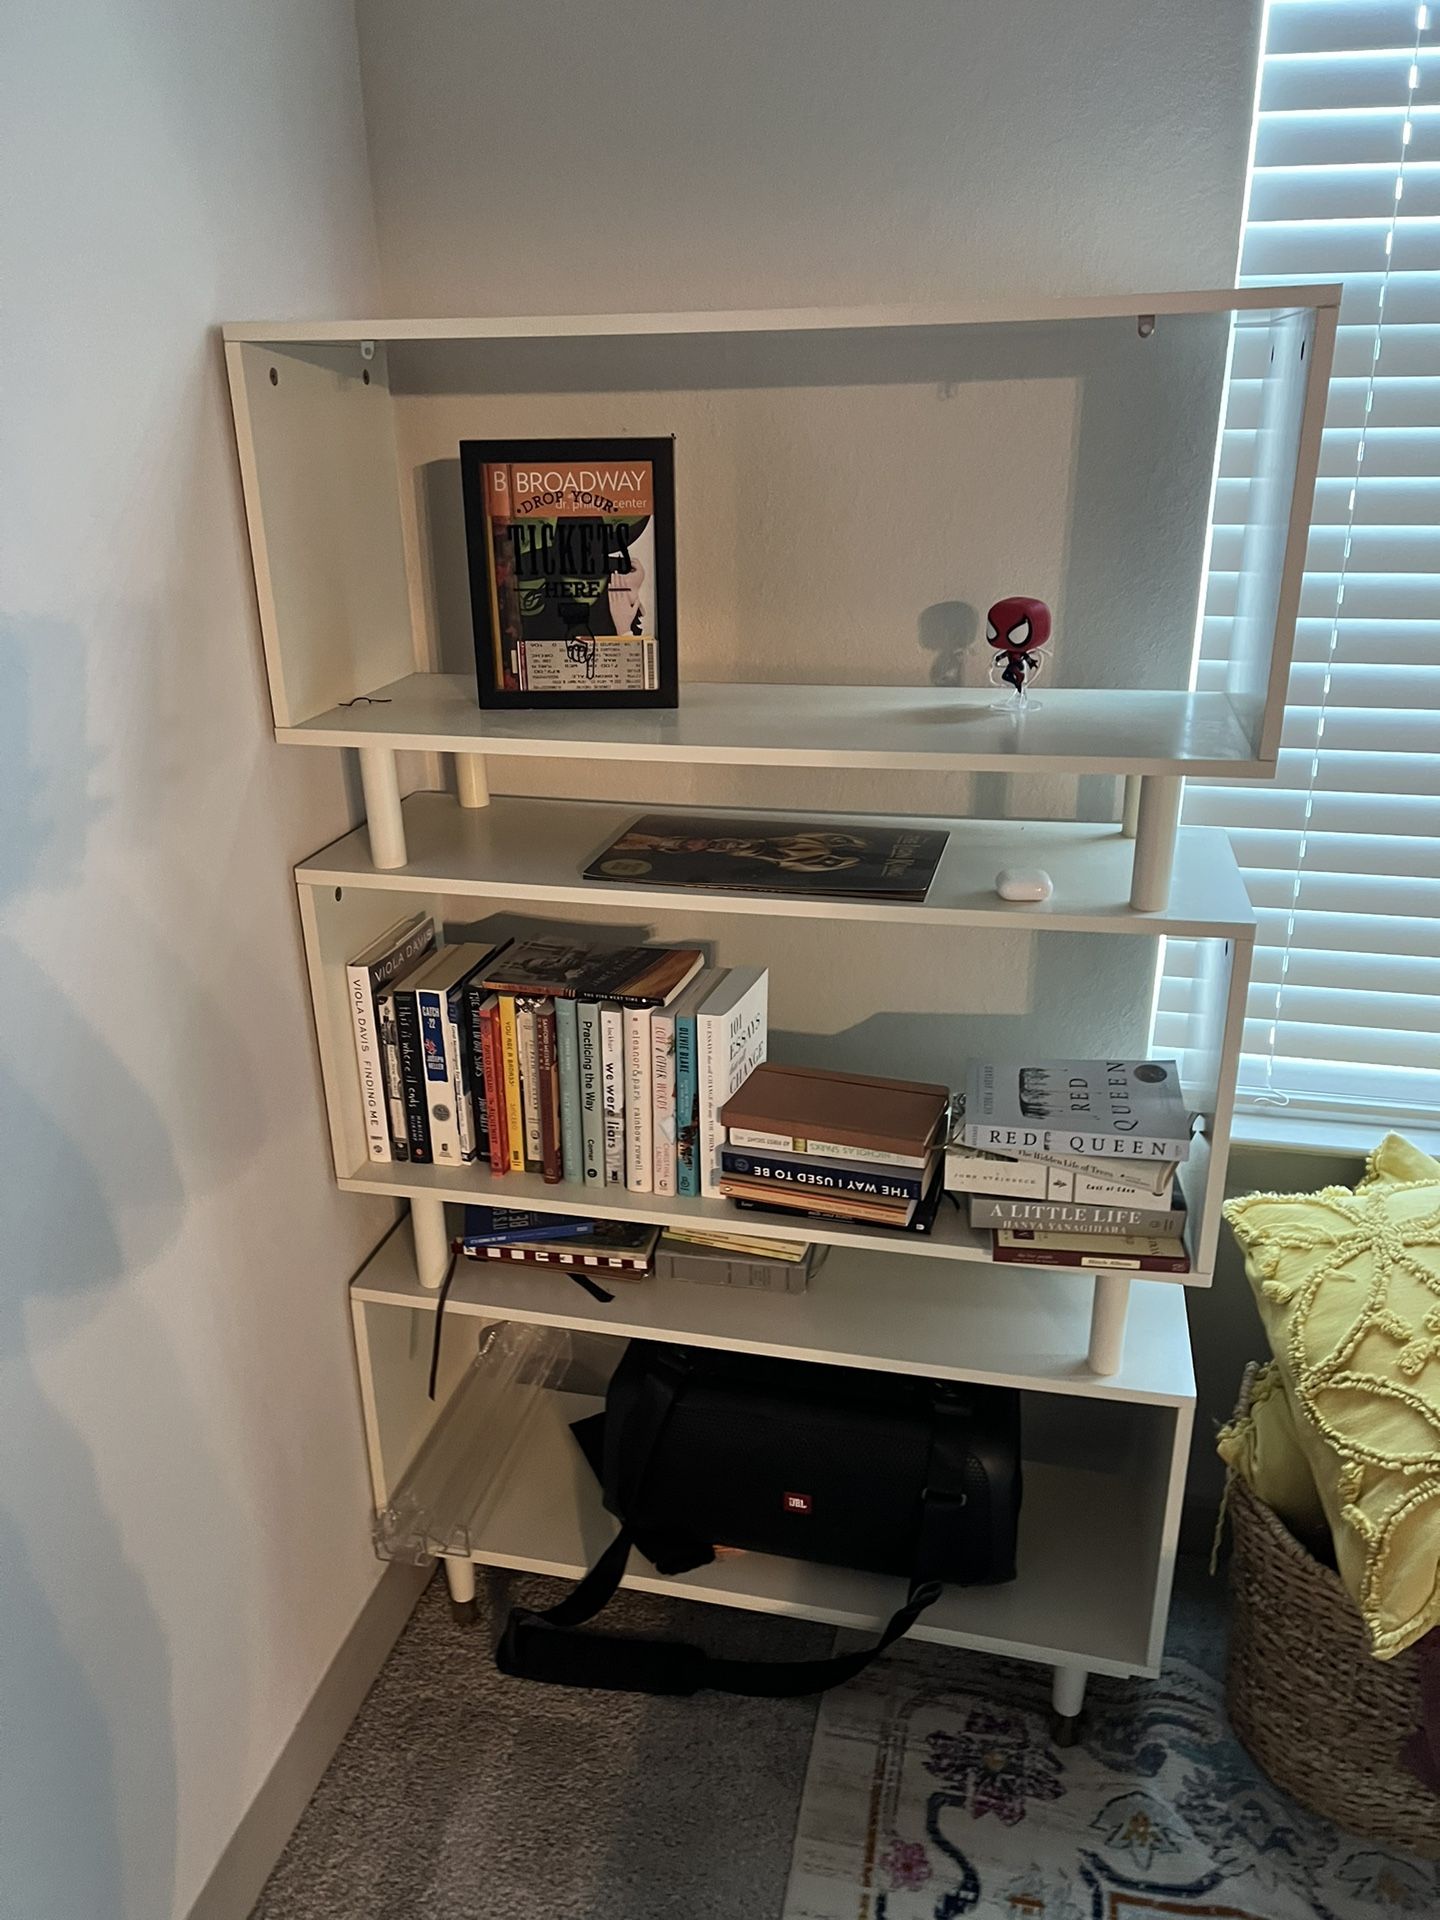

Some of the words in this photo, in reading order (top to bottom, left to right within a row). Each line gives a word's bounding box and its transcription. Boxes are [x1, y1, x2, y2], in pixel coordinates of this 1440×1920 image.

[493, 471, 507, 491] B
[516, 470, 646, 493] BROADWAY
[521, 491, 564, 514] DROP
[571, 490, 614, 513] YOUR
[507, 523, 633, 576] TICKETS
[544, 581, 601, 598] HERE
[374, 953, 405, 982] VIOLA
[406, 928, 433, 958] DAVIS
[353, 979, 367, 1014] VIOLA
[469, 991, 480, 1007] THE
[399, 1006, 411, 1026] this
[422, 1006, 440, 1018] CATCH
[357, 1018, 370, 1052] DAVIS
[401, 1030, 412, 1039] is
[504, 1021, 514, 1037] YOU
[542, 1018, 550, 1044] SANFORD
[655, 1026, 667, 1046] LOVE
[679, 1026, 690, 1050] OLIVIE
[730, 1012, 761, 1061] ESSAYS
[473, 1041, 483, 1054] OUR
[506, 1037, 514, 1050] ARE
[582, 1021, 594, 1071] Practicing
[402, 1042, 415, 1072] where
[543, 1045, 551, 1071] MEISNER
[656, 1054, 667, 1080] OTHER
[679, 1051, 690, 1073] BLAKE
[585, 1073, 595, 1089] the
[605, 1062, 615, 1080] we
[363, 1060, 376, 1107] FINDING
[407, 1087, 420, 1108] ends
[584, 1091, 596, 1112] Way
[606, 1084, 616, 1117] were
[656, 1082, 668, 1110] WORDS
[1068, 1077, 1090, 1113] RED
[1106, 1062, 1139, 1132] QUEEN
[369, 1110, 379, 1126] ME
[634, 1107, 643, 1142] rainbow
[607, 1121, 620, 1149] liars
[989, 1129, 1037, 1146] RED
[1069, 1136, 1167, 1156] QUEEN
[587, 1139, 595, 1162] Comer
[634, 1144, 643, 1171] rowell
[809, 1142, 841, 1154] SPARKS
[842, 1146, 891, 1160] NICHOLAS
[655, 1146, 663, 1173] LAUREN
[662, 1143, 670, 1178] CHRISTINA
[1017, 1150, 1032, 1160] The
[1033, 1152, 1063, 1168] Hidden
[1063, 1159, 1080, 1172] Life
[1080, 1162, 1090, 1173] of
[1090, 1165, 1113, 1178] Trees
[753, 1166, 771, 1178] BE
[774, 1169, 794, 1181] TO
[796, 1172, 834, 1187] USED
[837, 1178, 843, 1189] I
[845, 1180, 878, 1194] WAY
[880, 1184, 910, 1198] THE
[983, 1174, 1036, 1185] STEINBECK
[1086, 1184, 1102, 1192] East
[1106, 1185, 1114, 1193] of
[1116, 1186, 1136, 1194] Eden
[990, 1203, 1004, 1218] A
[1010, 1204, 1087, 1222] LITTLE
[1093, 1208, 1142, 1224] LIFE
[1003, 1219, 1043, 1231] HANYA
[1048, 1221, 1127, 1235] YANAGIHARA
[788, 1497, 808, 1509] JBL
